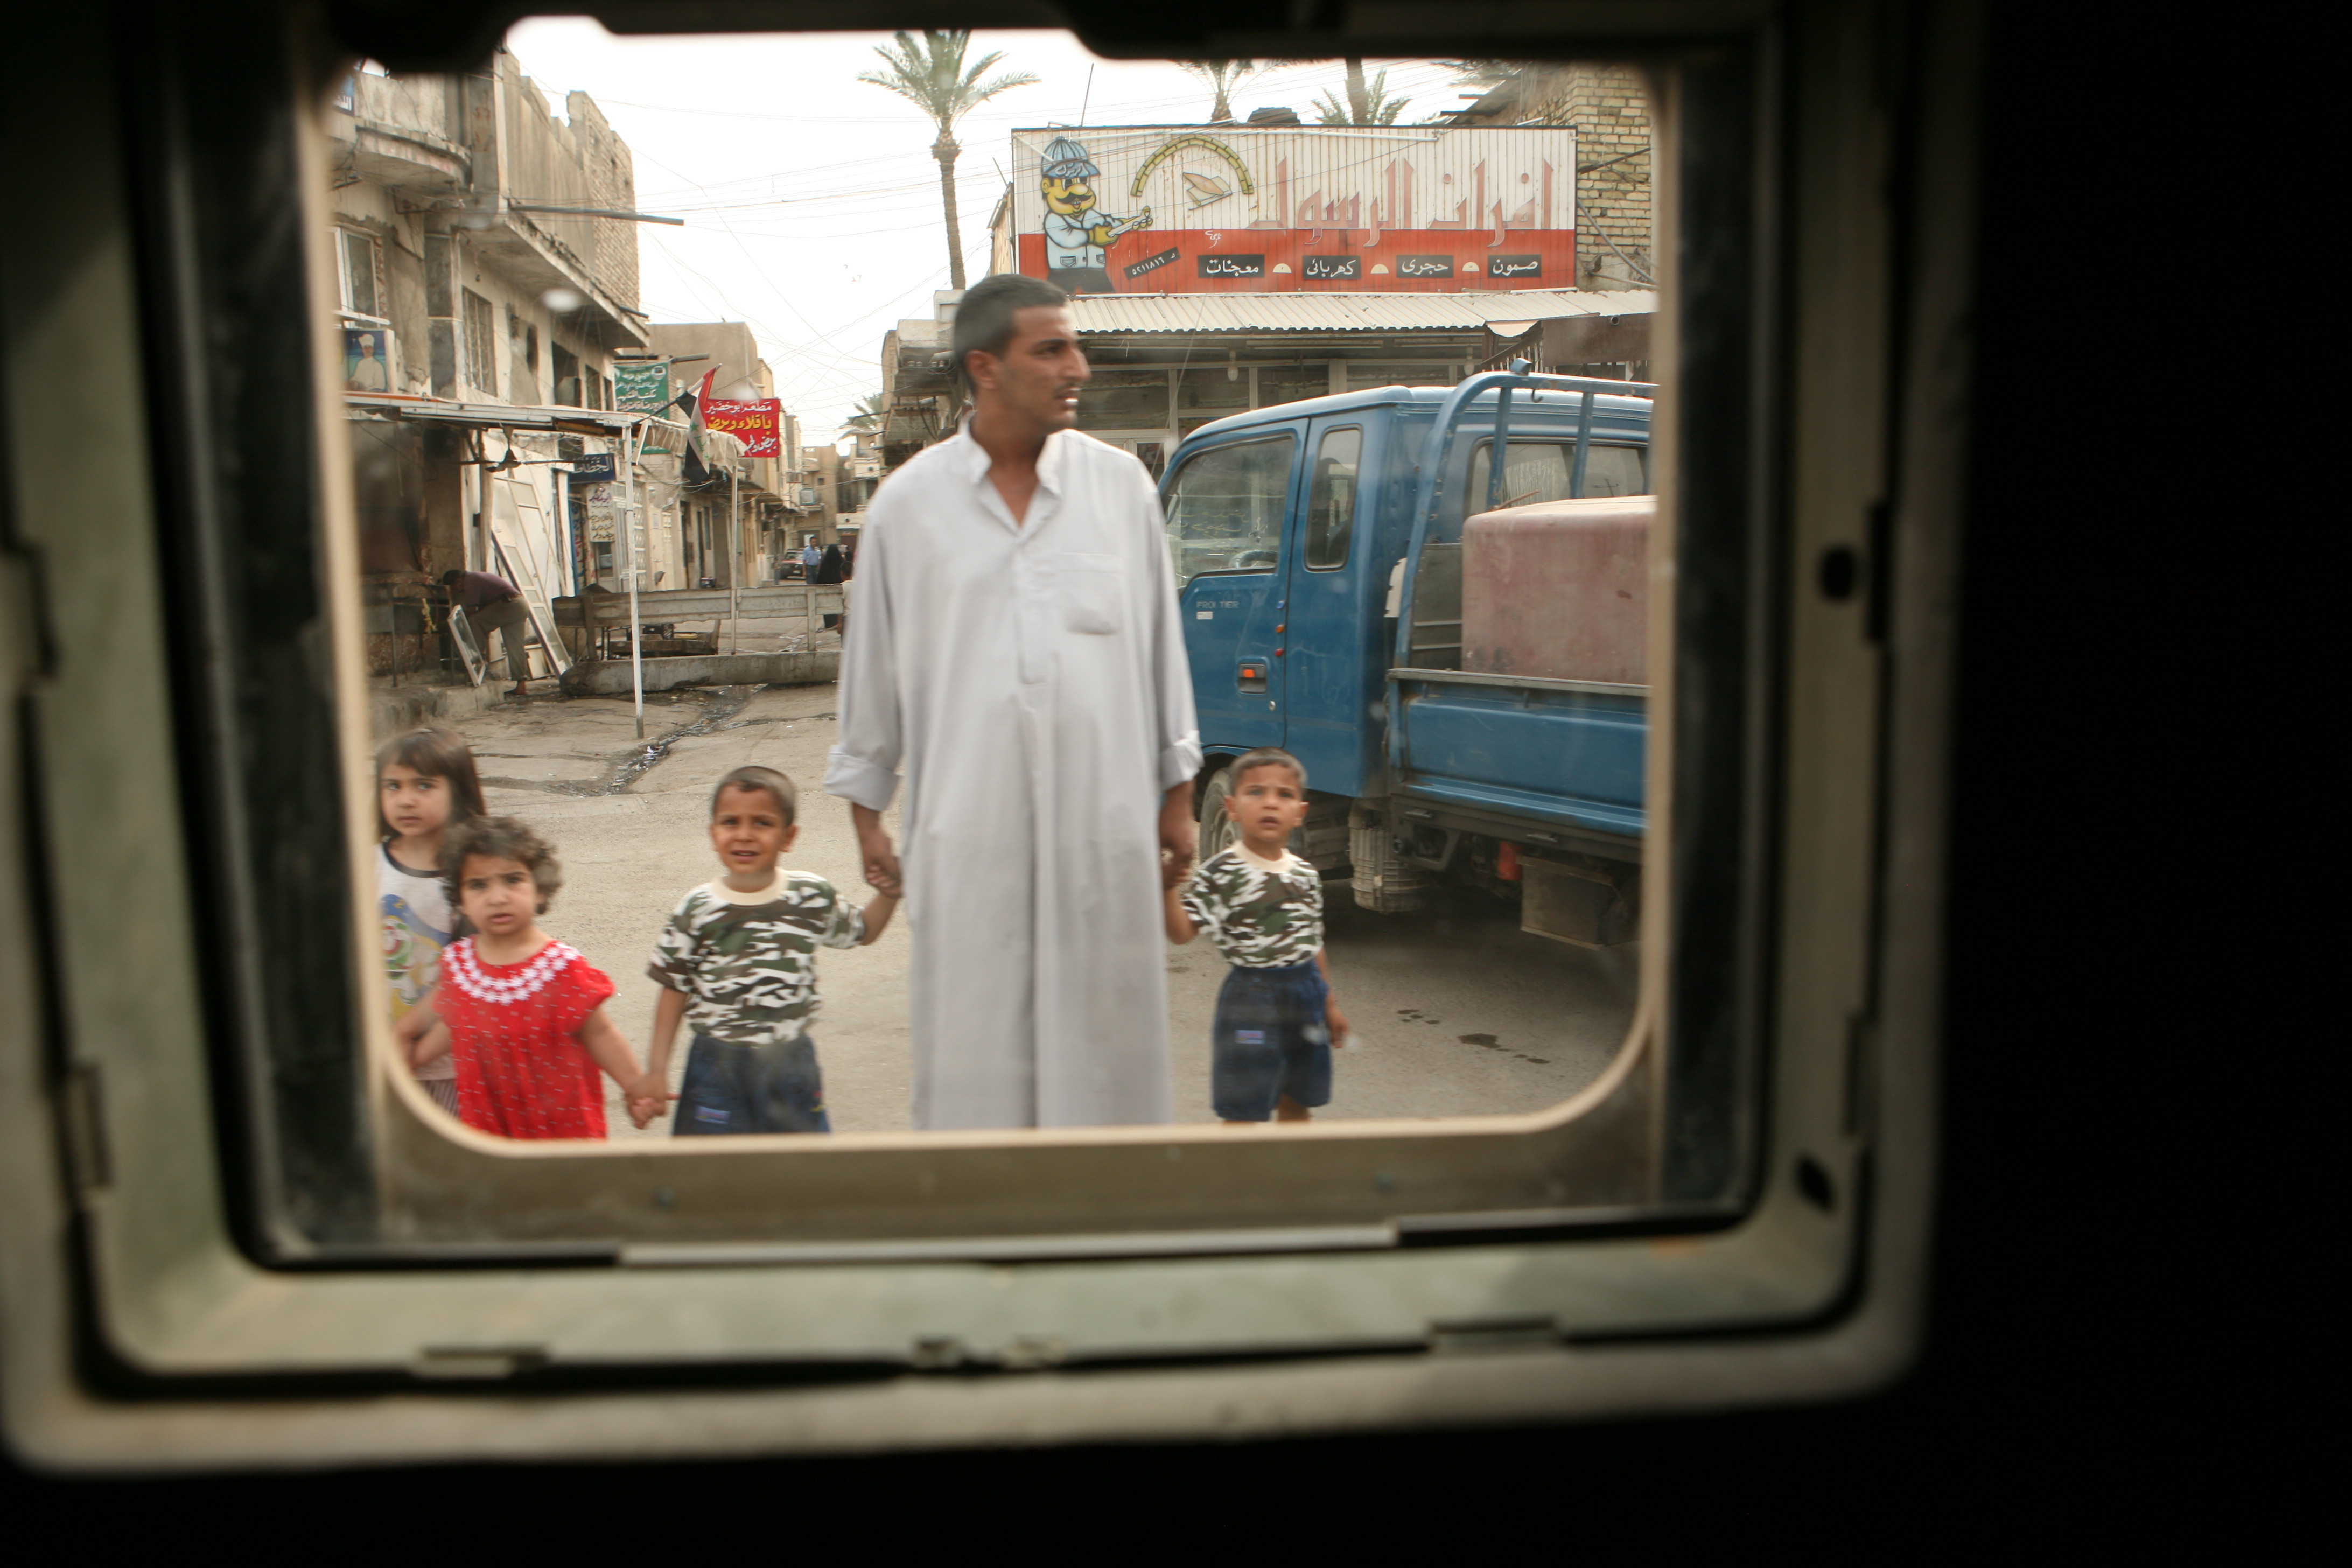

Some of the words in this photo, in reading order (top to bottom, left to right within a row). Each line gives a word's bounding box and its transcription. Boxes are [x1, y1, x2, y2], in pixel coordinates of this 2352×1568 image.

[1247, 156, 1413, 247] الرسول
[1206, 259, 1259, 276] معجنات
[1492, 259, 1538, 276] صمون
